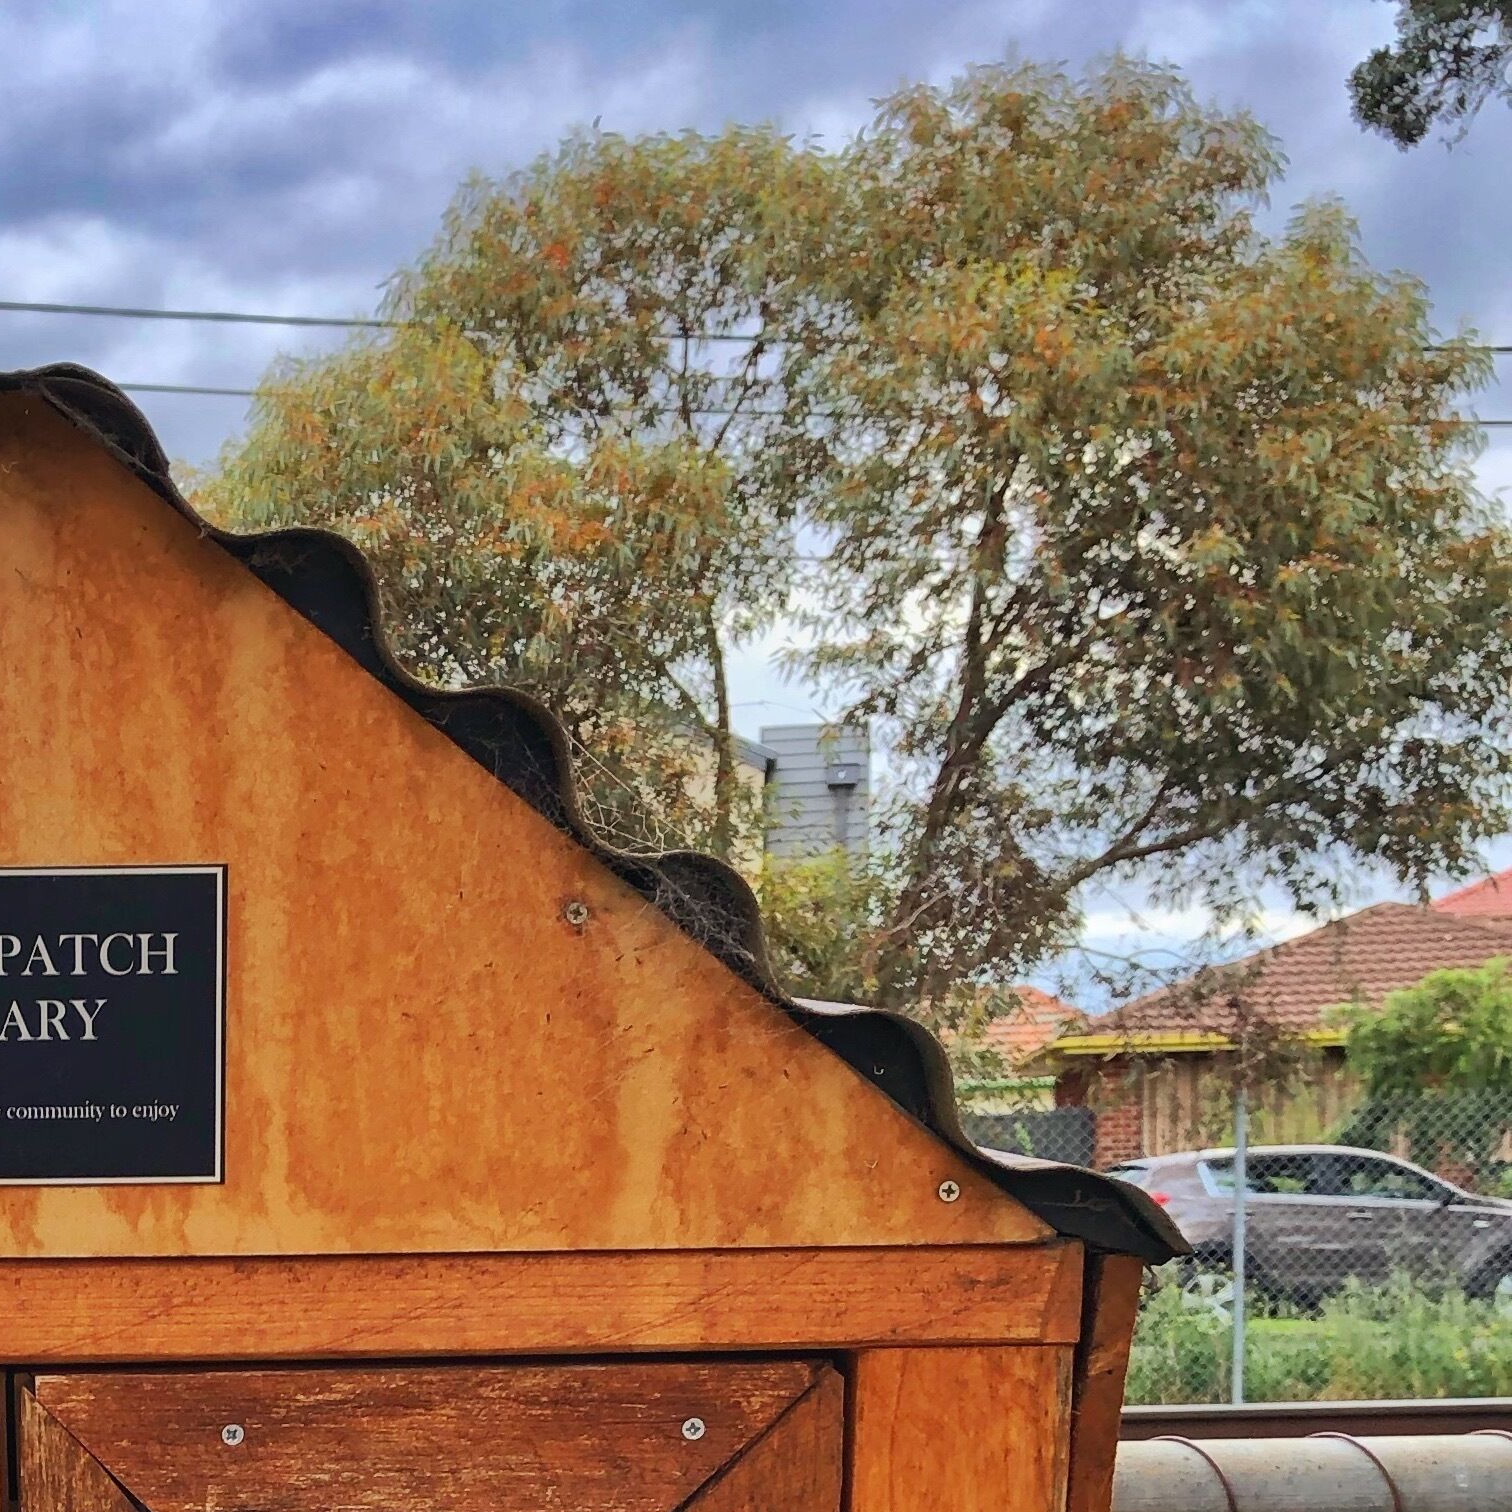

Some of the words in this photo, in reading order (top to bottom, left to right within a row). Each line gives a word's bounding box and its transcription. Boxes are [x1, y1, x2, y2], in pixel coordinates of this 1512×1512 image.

[6, 1099, 106, 1122] community
[109, 1100, 128, 1120] to
[131, 1099, 180, 1122] enjoy
